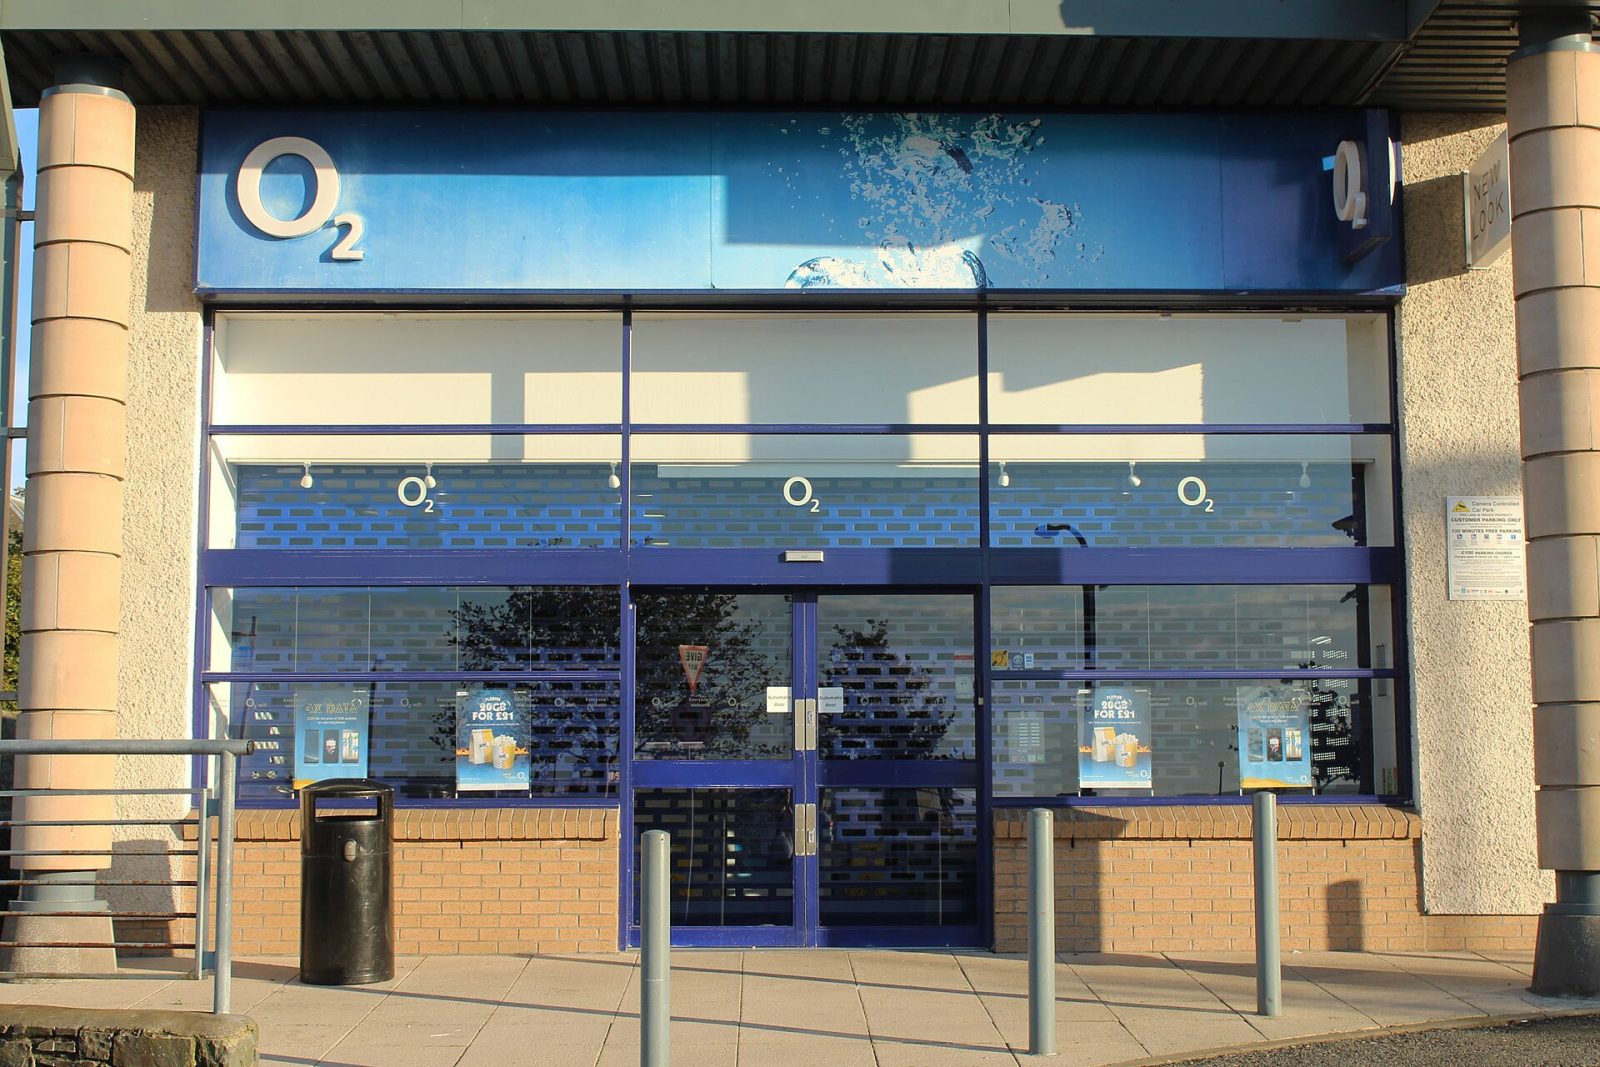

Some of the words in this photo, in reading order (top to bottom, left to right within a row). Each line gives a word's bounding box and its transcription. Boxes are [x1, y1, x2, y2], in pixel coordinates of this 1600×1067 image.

[1474, 161, 1500, 204] NEW
[1473, 192, 1504, 240] LOOK
[327, 703, 357, 714] DATA
[480, 702, 507, 711] 20GB
[1101, 700, 1128, 709] 20GB
[472, 712, 493, 720] FOR
[495, 712, 514, 720] £21
[1094, 710, 1115, 719] FOR
[1117, 710, 1135, 719] £21
